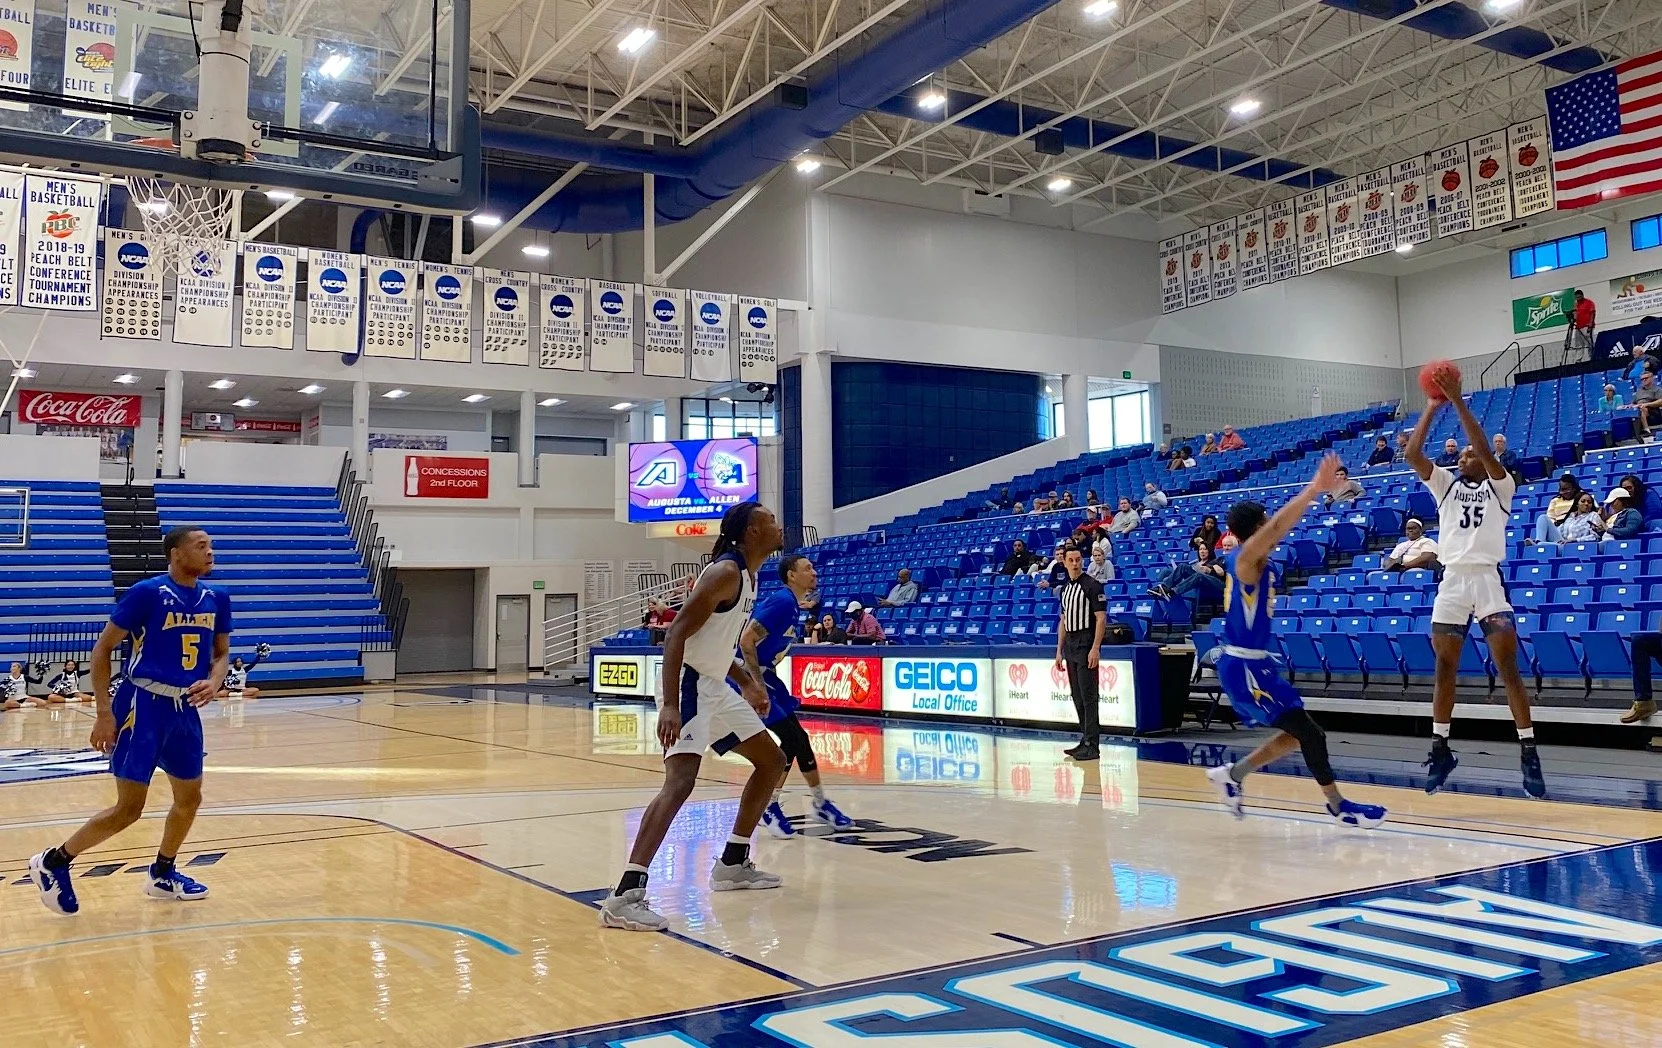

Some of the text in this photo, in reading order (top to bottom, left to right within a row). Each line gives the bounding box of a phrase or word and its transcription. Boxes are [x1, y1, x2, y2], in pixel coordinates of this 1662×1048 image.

[1, 70, 29, 84] FOUR
[66, 78, 95, 92] ELITE
[47, 181, 76, 194] MEN'S
[31, 191, 94, 208] BASKETBALL
[112, 231, 132, 239] MEN'S
[38, 241, 84, 253] 2018-19
[263, 248, 295, 256] BASKETBALL
[31, 253, 92, 267] PEACH BELT
[322, 252, 348, 260] WOMEN'S
[315, 260, 354, 269] BASKETBALL
[30, 266, 91, 280] CONFERENCE
[114, 271, 144, 279] DIVISION
[30, 279, 91, 293] TOURNAMENT
[109, 279, 158, 290] CHAMPIONSHIP
[199, 280, 225, 288] DIVISION
[29, 292, 90, 306] CHAMPIONS
[108, 289, 158, 299] APPEARANCES
[181, 288, 228, 298] CHAMPIONSHIP
[248, 291, 290, 300] CHAMPIONSHIP
[181, 298, 228, 308] APPEARANCES
[250, 300, 288, 309] PARTICIPANT
[312, 301, 355, 311] CHAMPIONSHIP
[314, 309, 352, 318] PARTICIPANT
[1530, 300, 1559, 325] Sprite
[26, 392, 133, 424] Coca-Cola
[422, 468, 487, 476] CONCESSIONS
[648, 497, 692, 506] AUGUSTA
[1455, 489, 1490, 503] AUGUSTA
[665, 506, 713, 515] DECEMBER
[1460, 506, 1484, 528] 35
[676, 523, 707, 536] Coke
[162, 612, 215, 630] ALLEN
[182, 634, 200, 670] 5
[601, 664, 637, 686] EZGO
[801, 662, 853, 700] Coca-Cola
[895, 662, 977, 692] GEICO
[1009, 691, 1028, 699] iHeart
[1051, 692, 1073, 701] iHeart
[913, 693, 977, 712] Local Office
